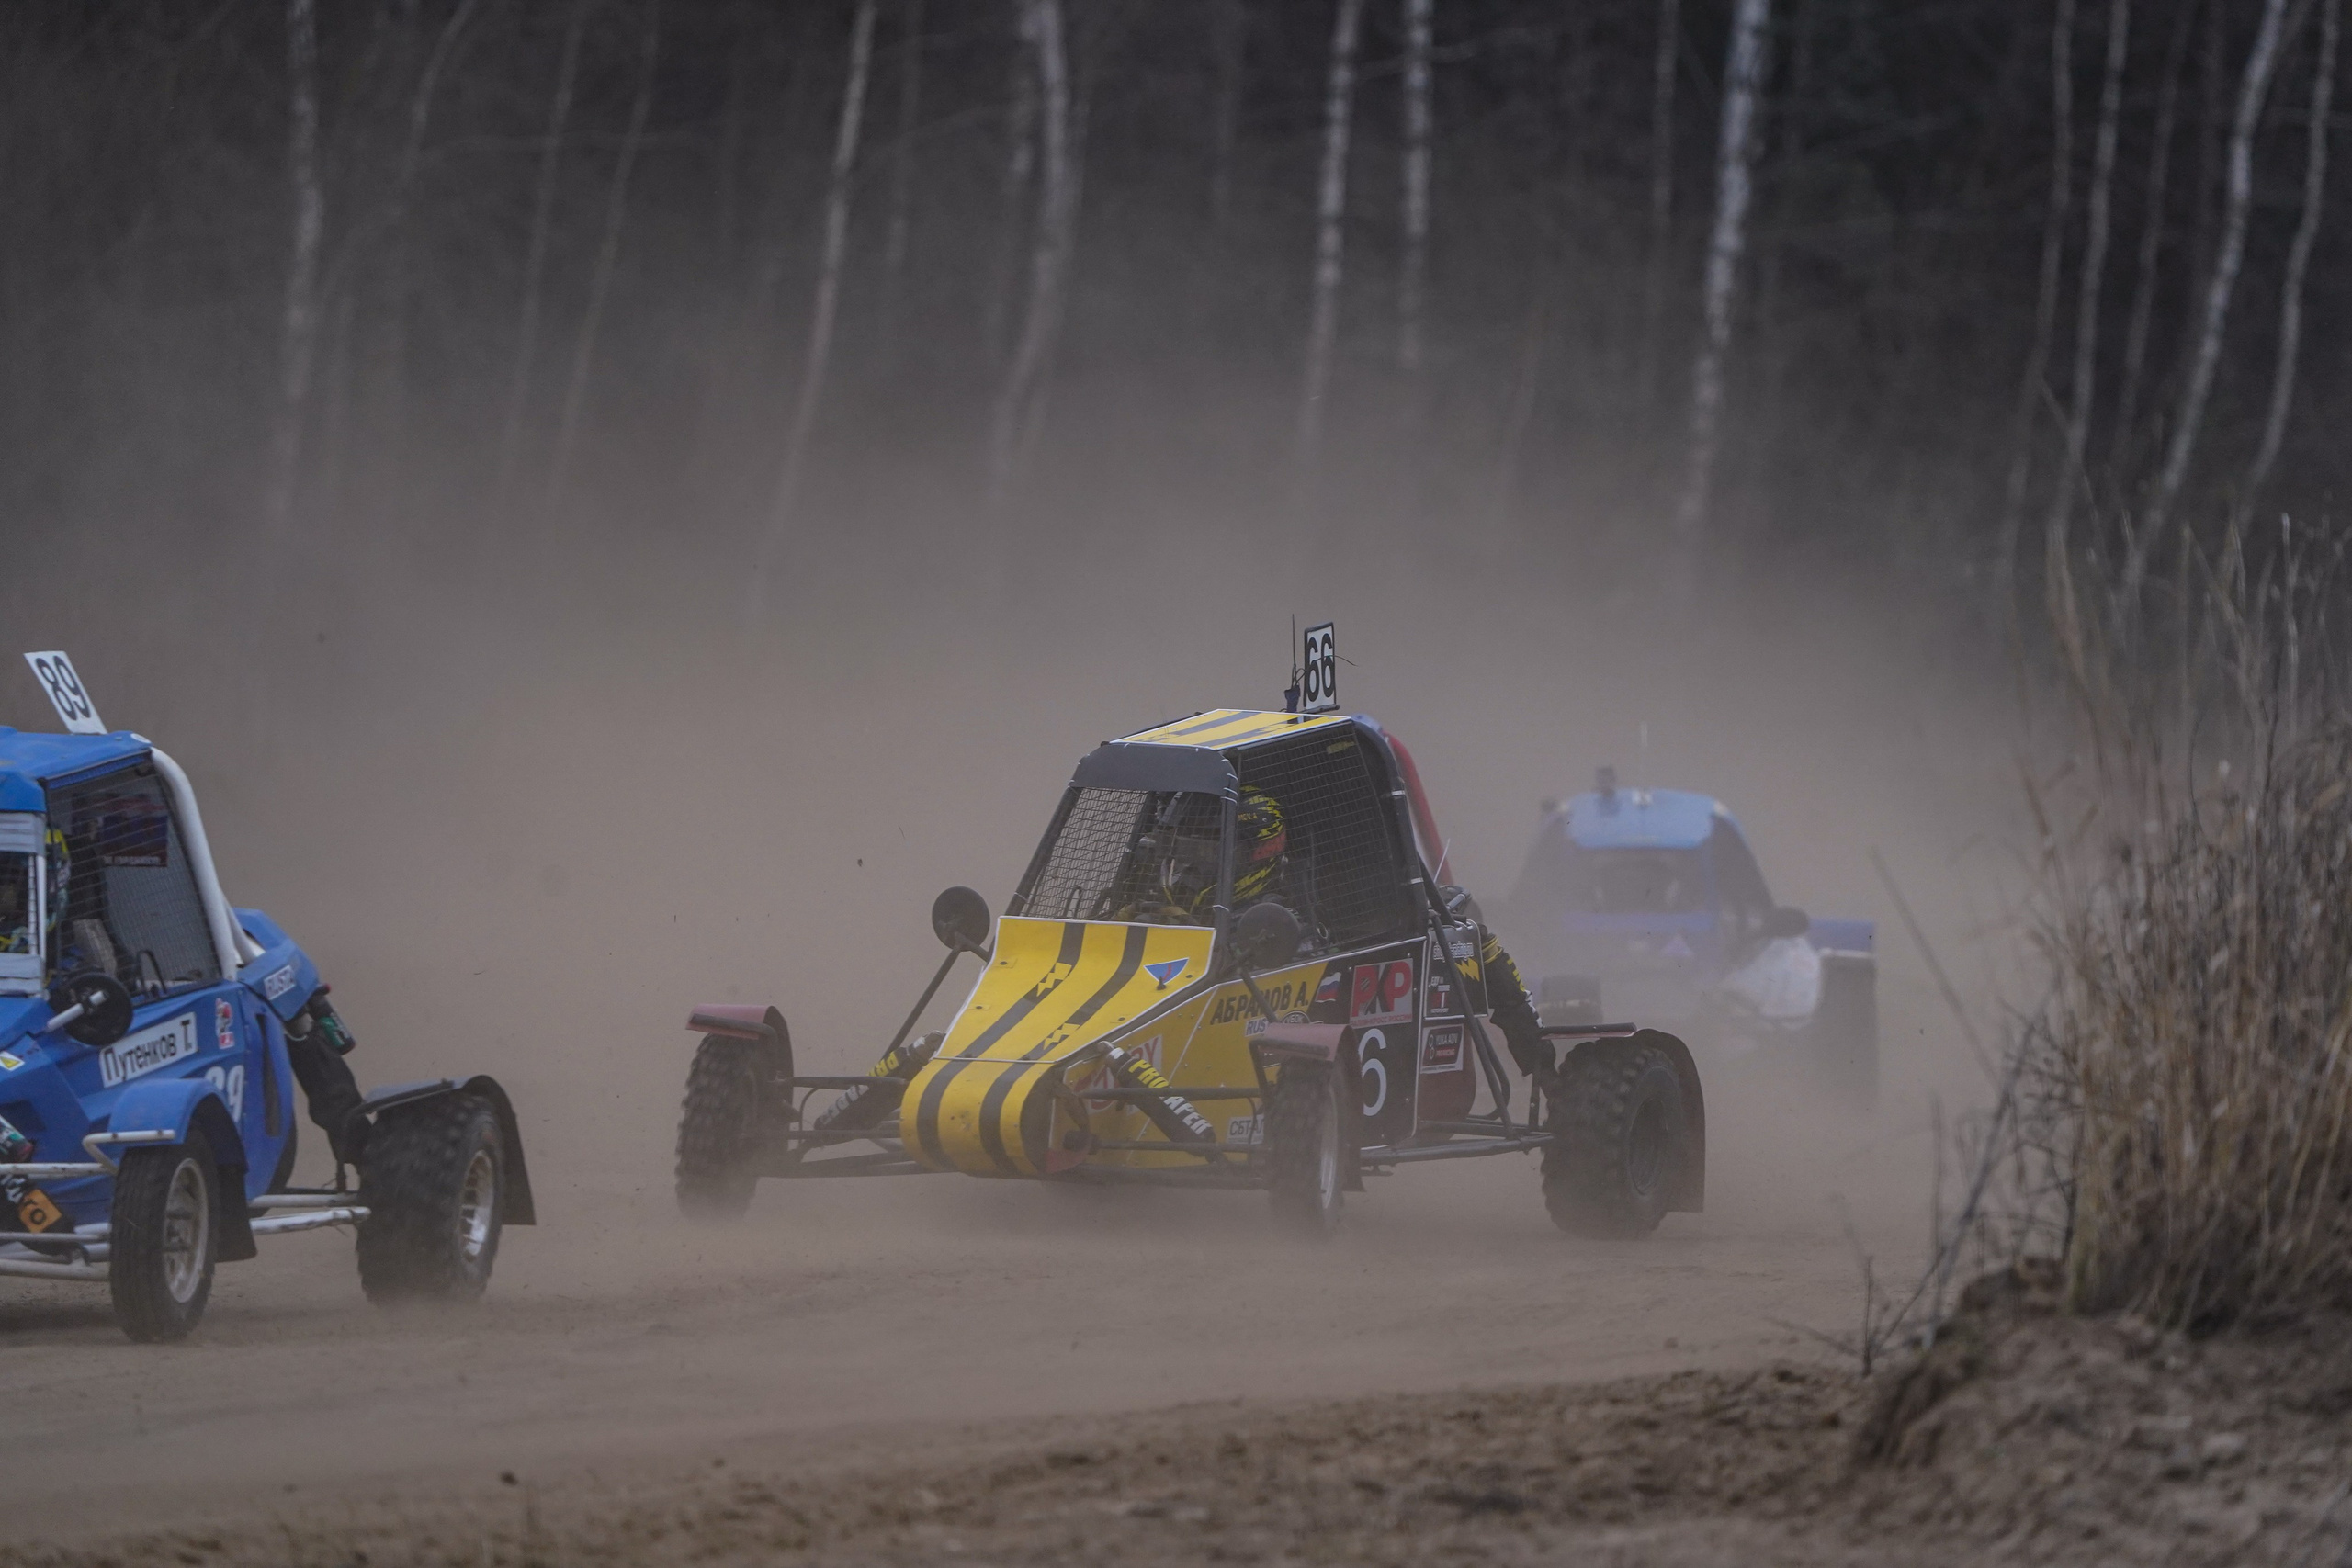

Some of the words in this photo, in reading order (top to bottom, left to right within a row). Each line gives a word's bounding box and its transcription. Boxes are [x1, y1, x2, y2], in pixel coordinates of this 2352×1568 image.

[35, 655, 91, 721] 89
[1305, 632, 1335, 703] 66
[1294, 981, 1309, 1008] А.
[103, 1033, 177, 1082] Путенков
[181, 1020, 193, 1052] Т.
[1159, 1096, 1213, 1135] APER
